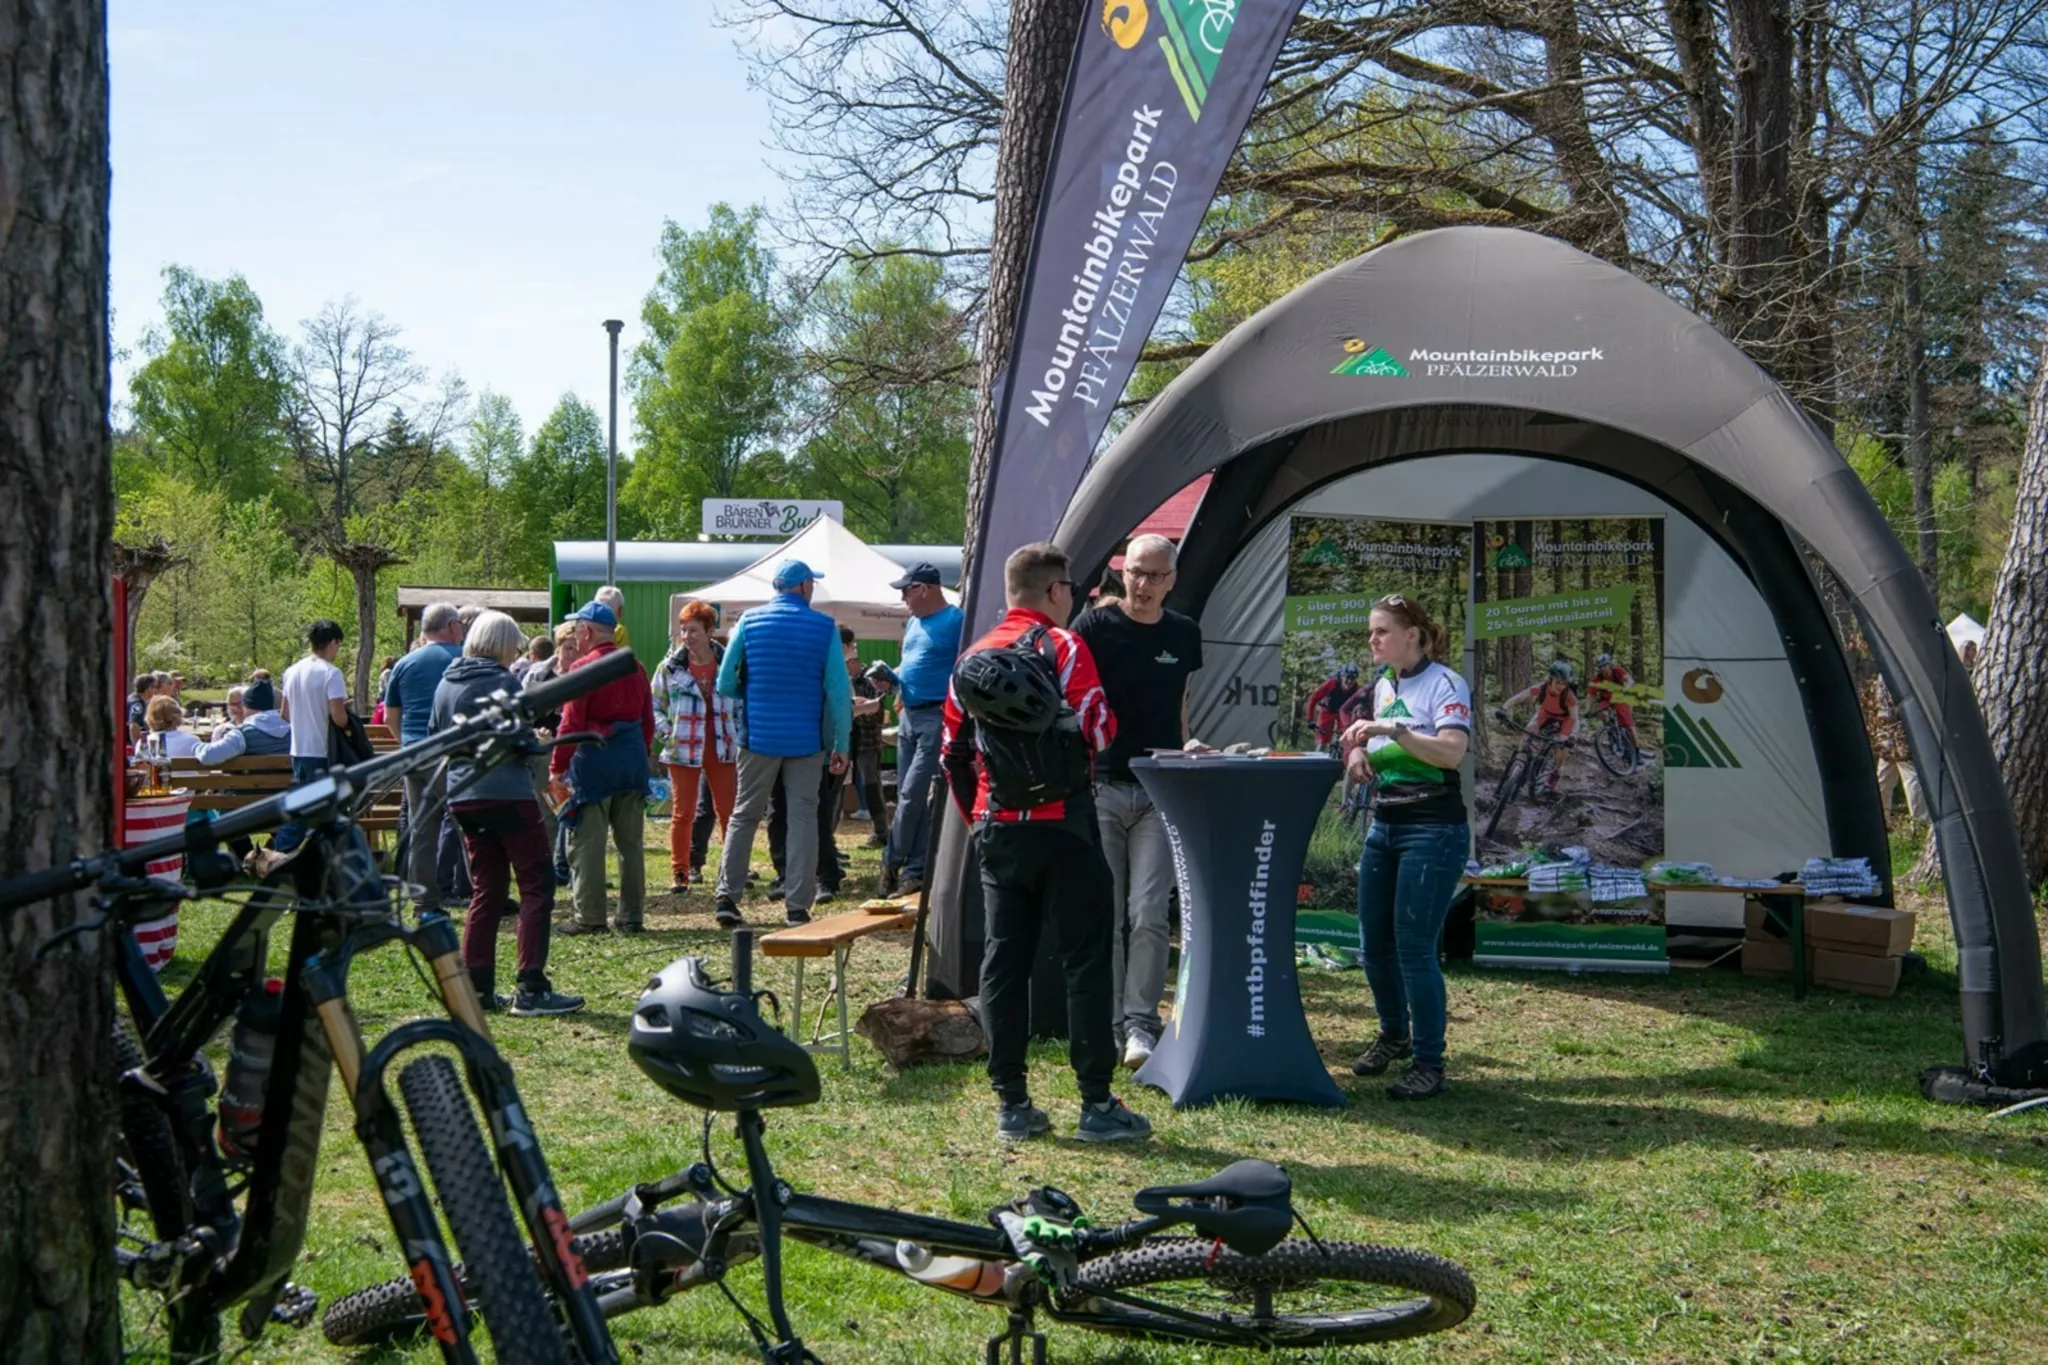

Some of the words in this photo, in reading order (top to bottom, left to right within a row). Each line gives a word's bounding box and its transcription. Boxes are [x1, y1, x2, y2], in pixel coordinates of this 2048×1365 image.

[1024, 103, 1164, 428] Mountainbikepark
[1072, 160, 1179, 408] PFÄLZERWALD
[1409, 347, 1604, 364] Mountainbikepark
[1426, 362, 1578, 377] PFÄLZERWALD
[724, 504, 763, 518] BÄREN
[715, 515, 772, 529] BRUNNER
[1346, 541, 1463, 558] Mountainbikepark
[1533, 540, 1655, 553] Mountainbikepark
[1308, 600, 1337, 611] über
[1341, 598, 1366, 609] 900
[1485, 607, 1500, 617] 20
[1504, 603, 1545, 615] Touren
[1548, 600, 1569, 610] mit
[1572, 597, 1590, 607] bis
[1594, 596, 1608, 605] zu
[1296, 615, 1315, 626] für
[1319, 613, 1369, 625] Pfadfin
[1486, 618, 1513, 631] 25%
[1516, 607, 1614, 628] Singletrailanteil
[1246, 819, 1276, 1039] #mtbpfadfinder
